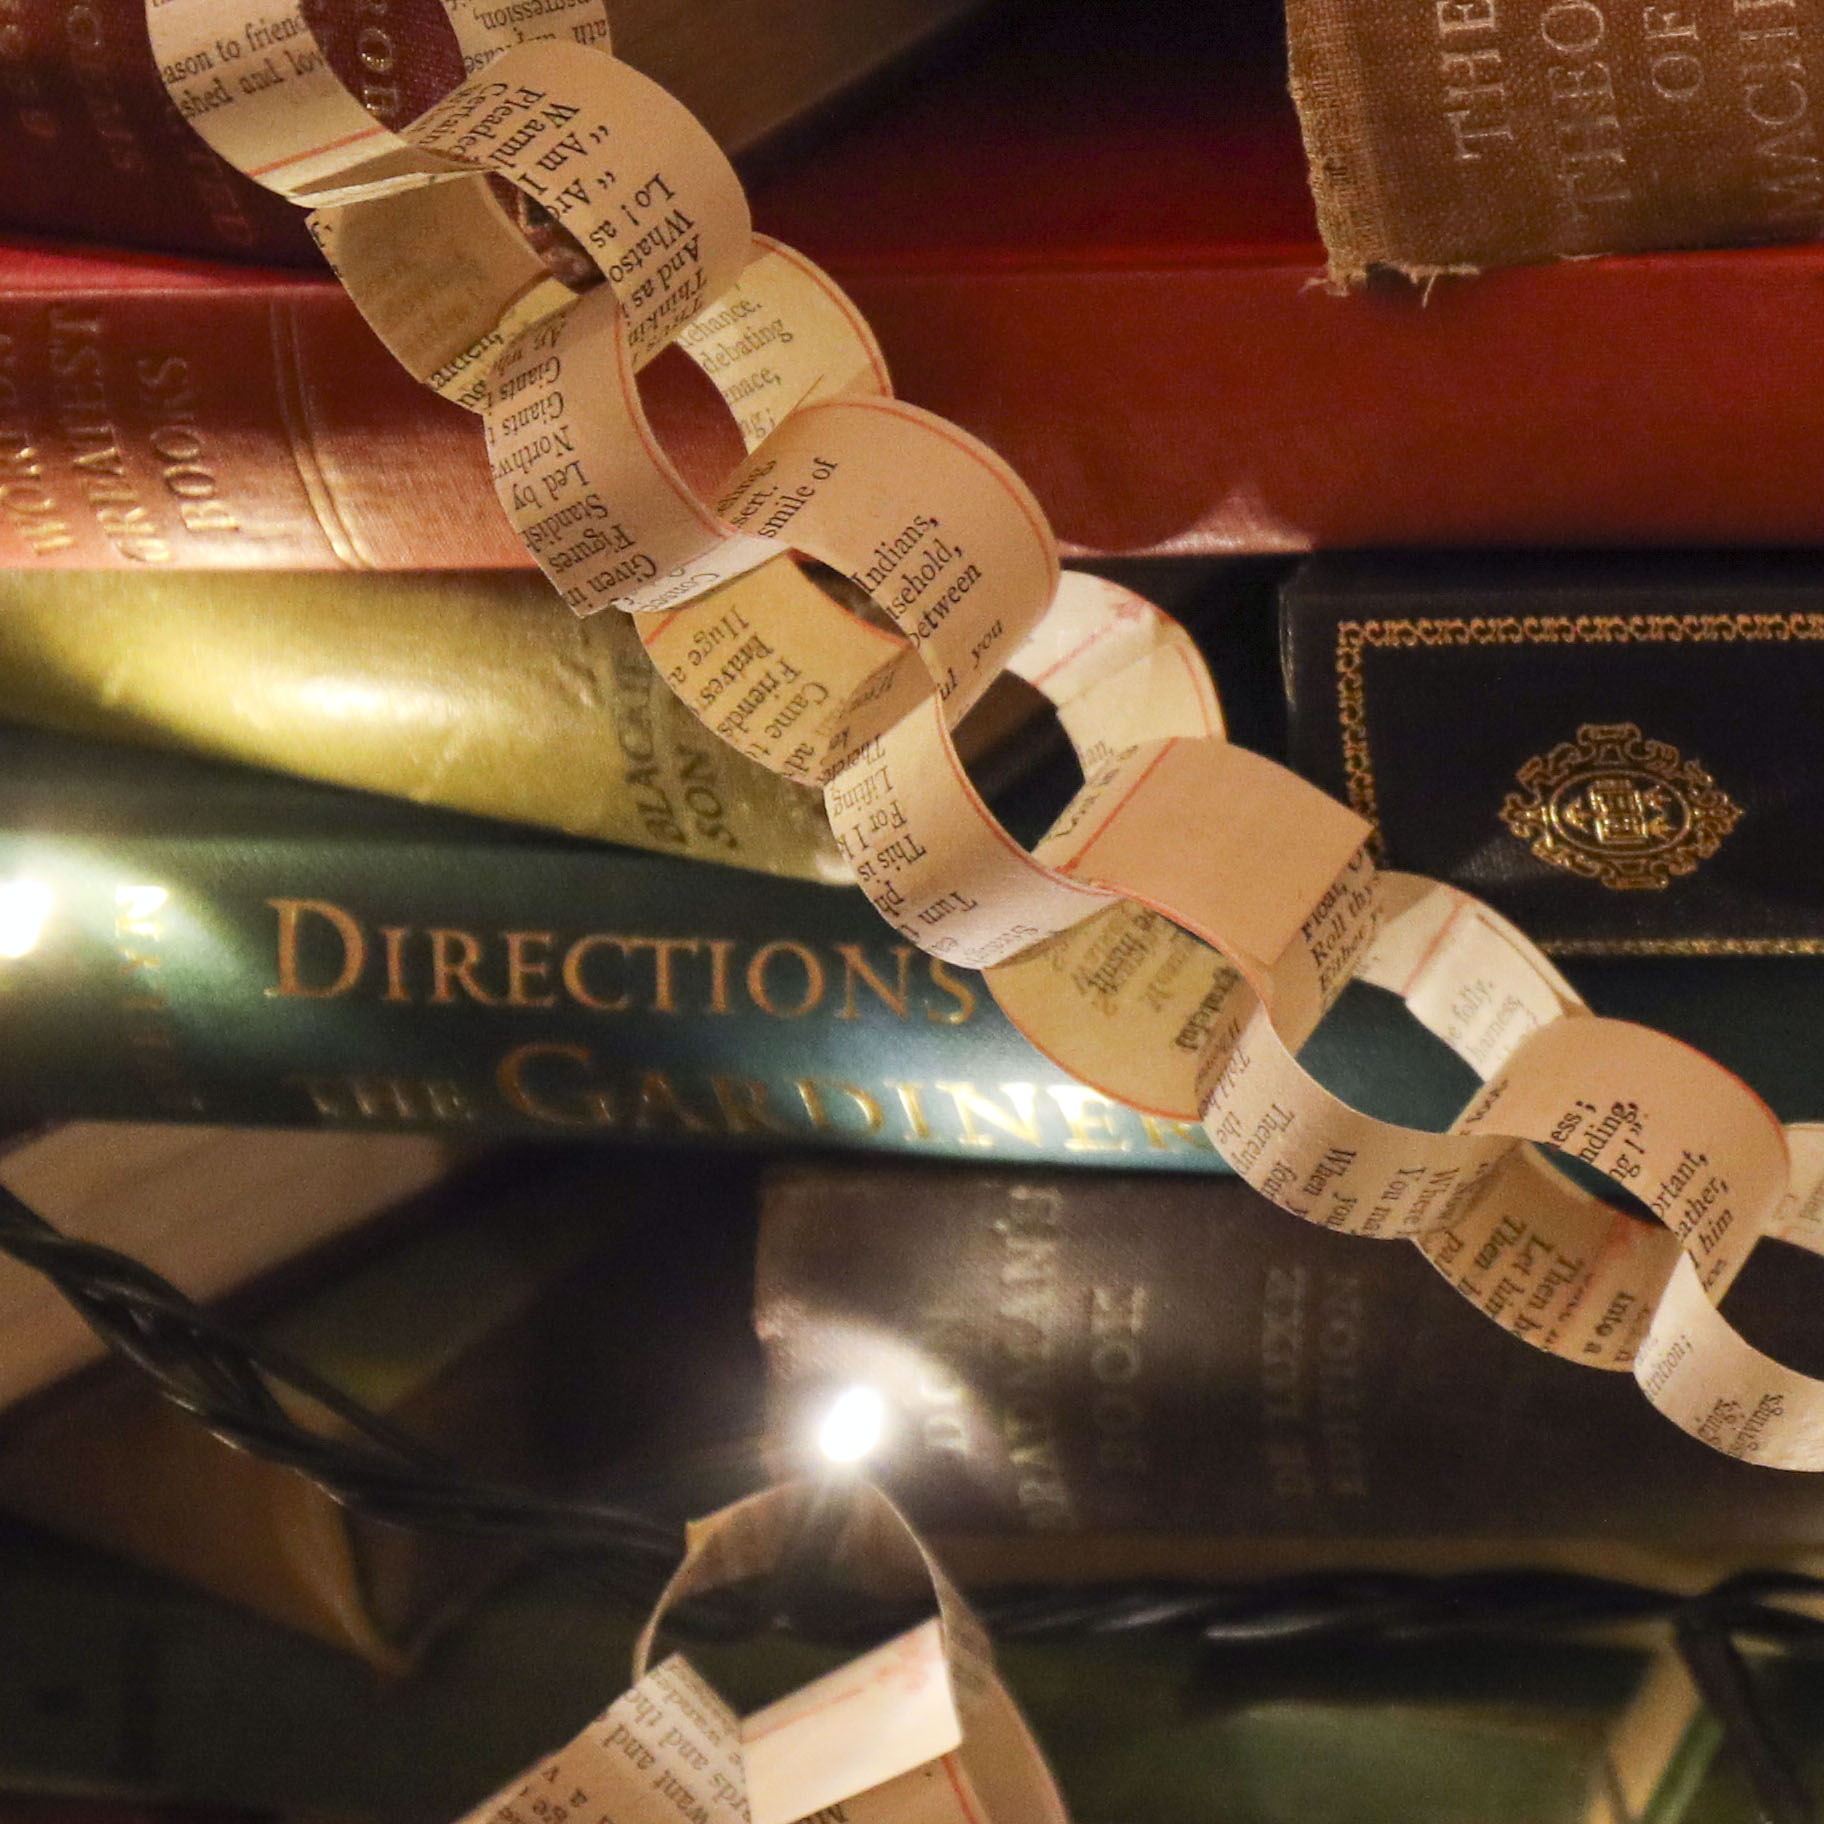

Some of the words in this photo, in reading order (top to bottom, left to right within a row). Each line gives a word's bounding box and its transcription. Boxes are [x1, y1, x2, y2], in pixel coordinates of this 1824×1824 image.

[1642, 4, 1704, 103] OF
[241, 67, 285, 96] and
[540, 132, 588, 174] Am
[499, 354, 561, 402] Giants
[500, 390, 565, 437] Giants
[139, 356, 238, 532] BOOKS
[512, 482, 546, 512] by
[541, 459, 589, 500] Led
[759, 486, 814, 540] smile
[547, 522, 637, 576] Figures
[587, 550, 657, 593] Given
[878, 832, 927, 872] This
[917, 890, 979, 928] Turn
[262, 896, 977, 1025] DIRECTIONS
[1300, 1146, 1358, 1196] When
[1475, 1212, 1528, 1273] Then
[1701, 1207, 1735, 1254] him
